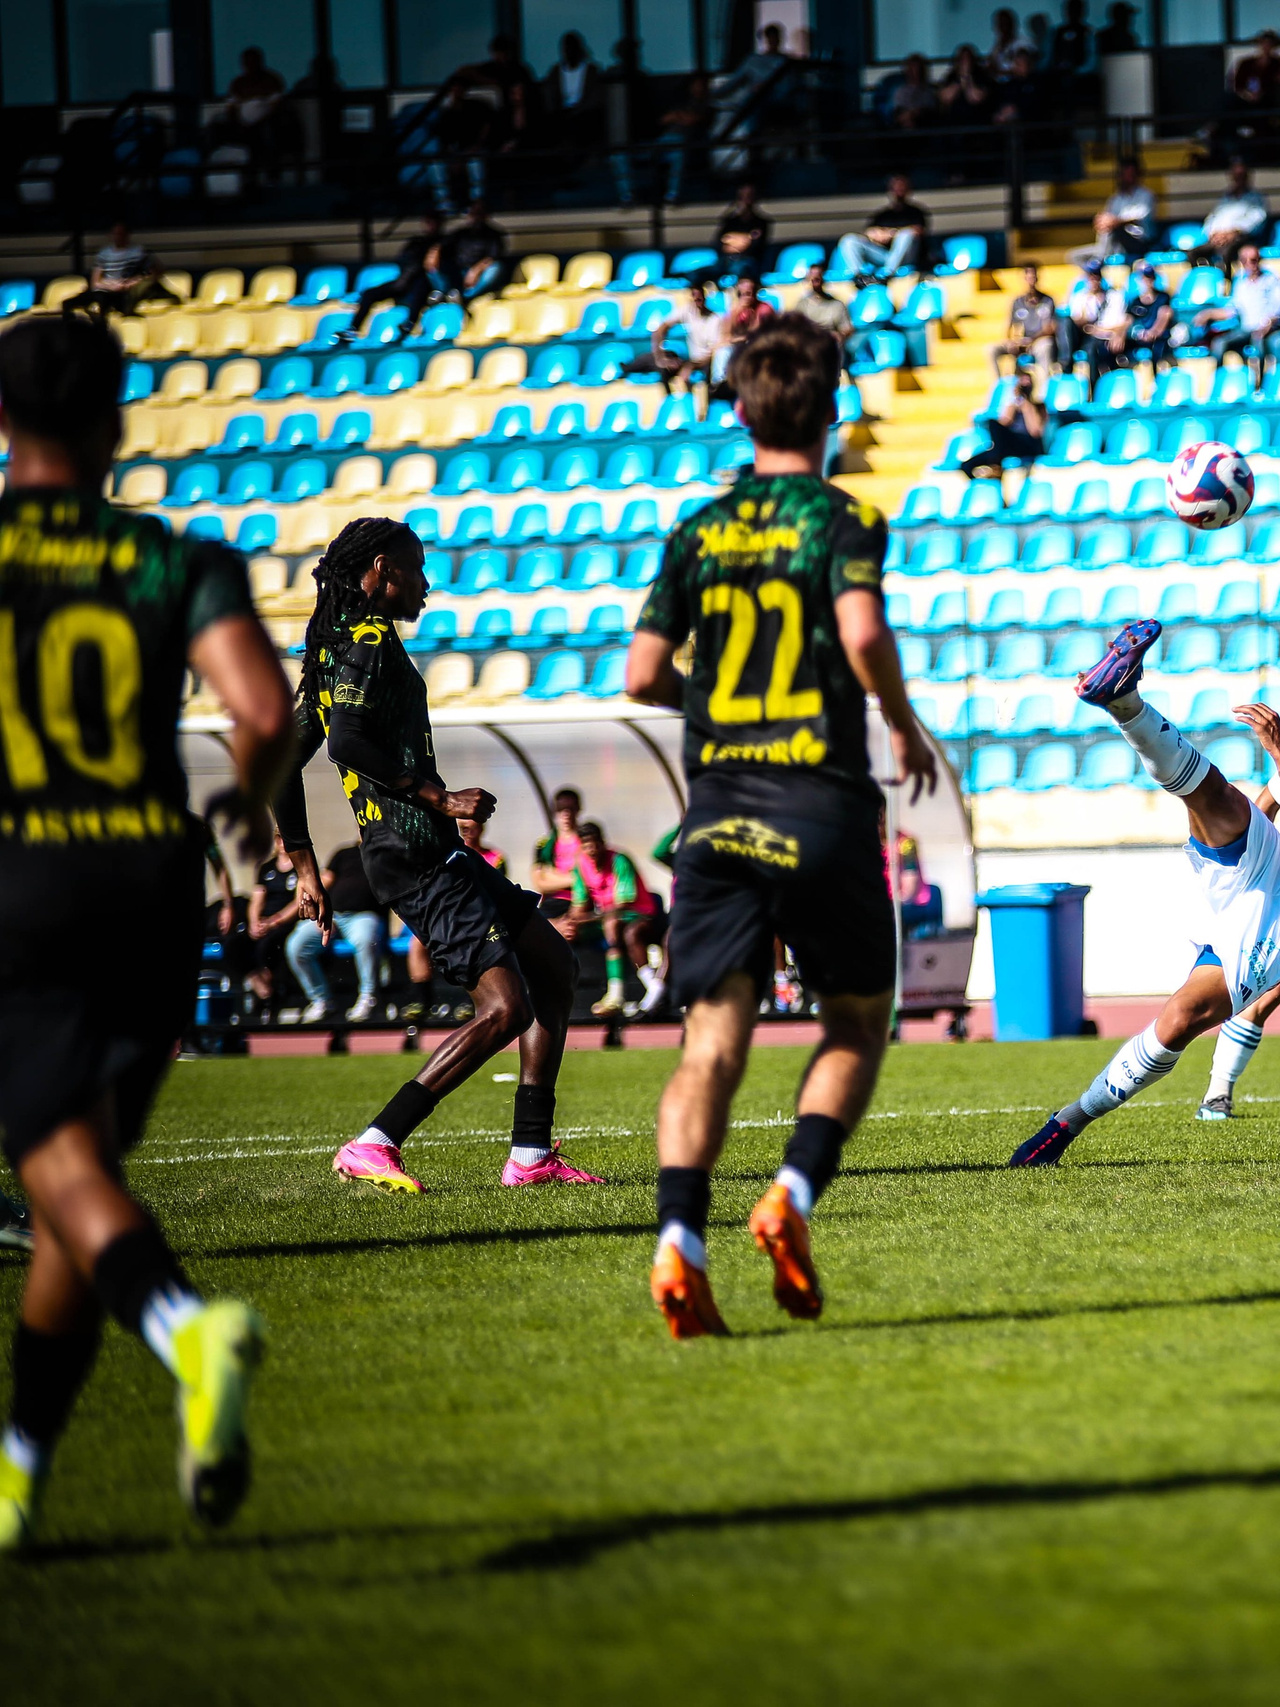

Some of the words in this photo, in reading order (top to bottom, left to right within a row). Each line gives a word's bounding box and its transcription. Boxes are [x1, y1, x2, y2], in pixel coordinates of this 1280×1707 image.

[0, 604, 143, 789] 10
[701, 578, 823, 724] 22
[711, 839, 799, 869] TONYCAR
